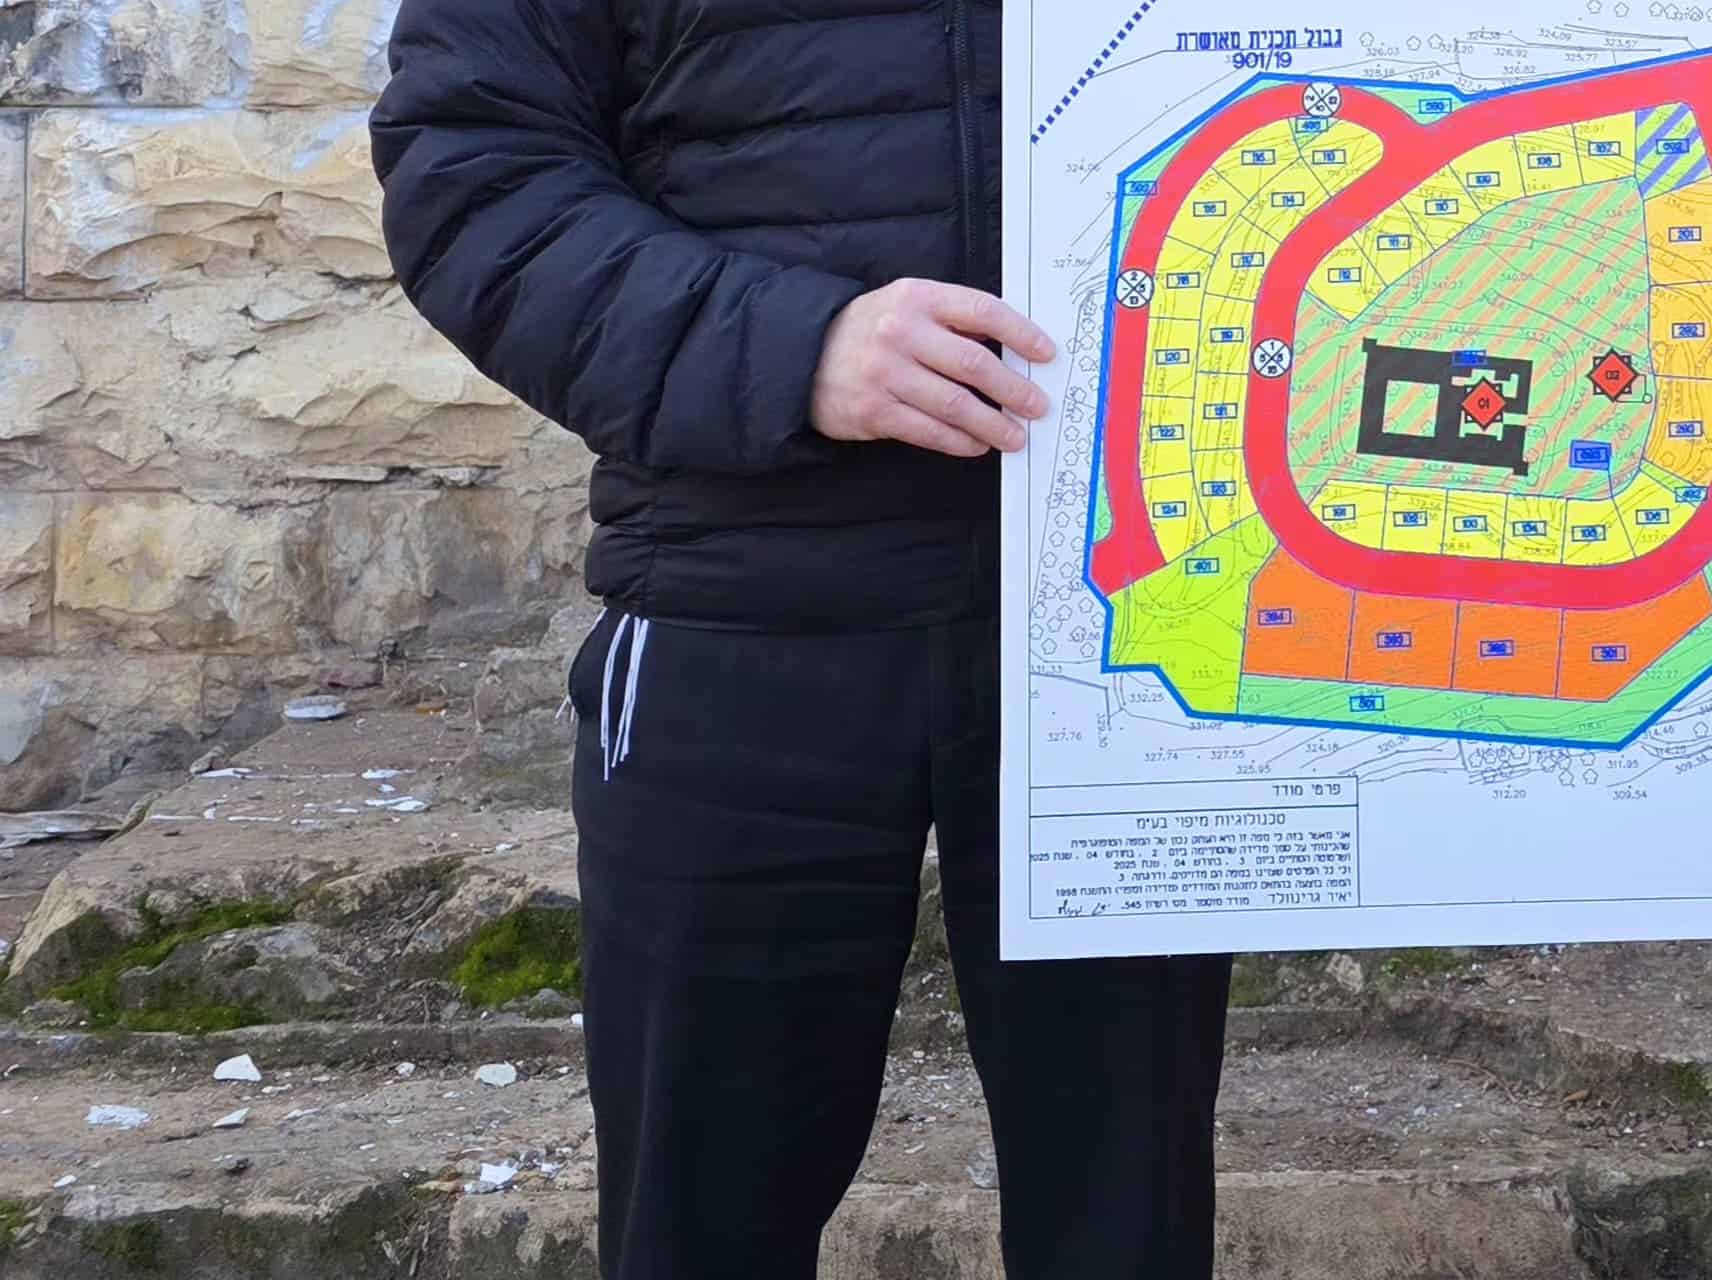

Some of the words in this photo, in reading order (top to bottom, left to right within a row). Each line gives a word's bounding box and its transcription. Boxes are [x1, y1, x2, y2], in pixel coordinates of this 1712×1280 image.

[1176, 32, 1240, 50] מאושרת
[1249, 31, 1296, 49] תכנית
[1304, 28, 1342, 48] גבול
[1232, 52, 1291, 70] 901/19
[1273, 785, 1303, 797] מודד
[1613, 791, 1647, 800] 309.54
[1176, 816, 1208, 829] מיפוי
[1215, 813, 1285, 828] טכנולוגיות
[1267, 893, 1320, 905] גרינוולד
[1328, 892, 1351, 902] יאיר
